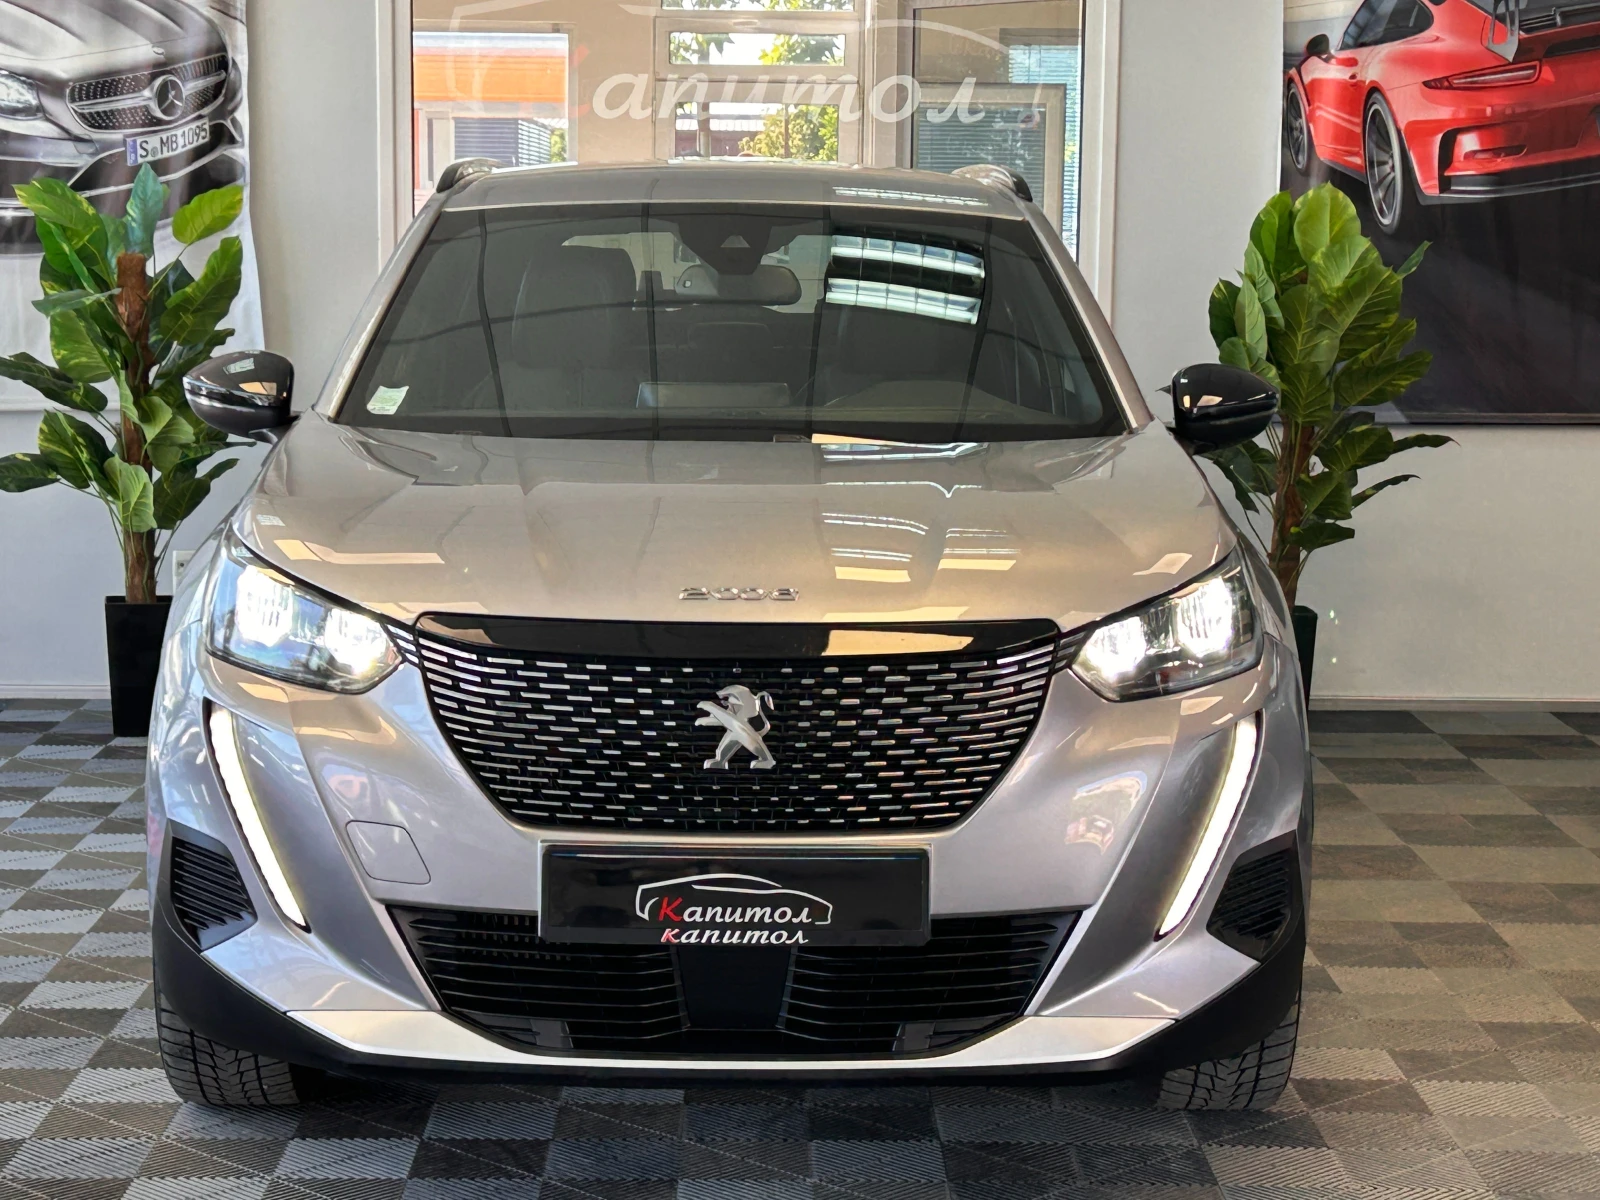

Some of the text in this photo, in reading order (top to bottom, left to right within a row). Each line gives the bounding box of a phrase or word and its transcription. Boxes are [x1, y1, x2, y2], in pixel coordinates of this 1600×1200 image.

[139, 140, 150, 159] S
[678, 587, 800, 601] 2008
[658, 896, 813, 924] Капитол
